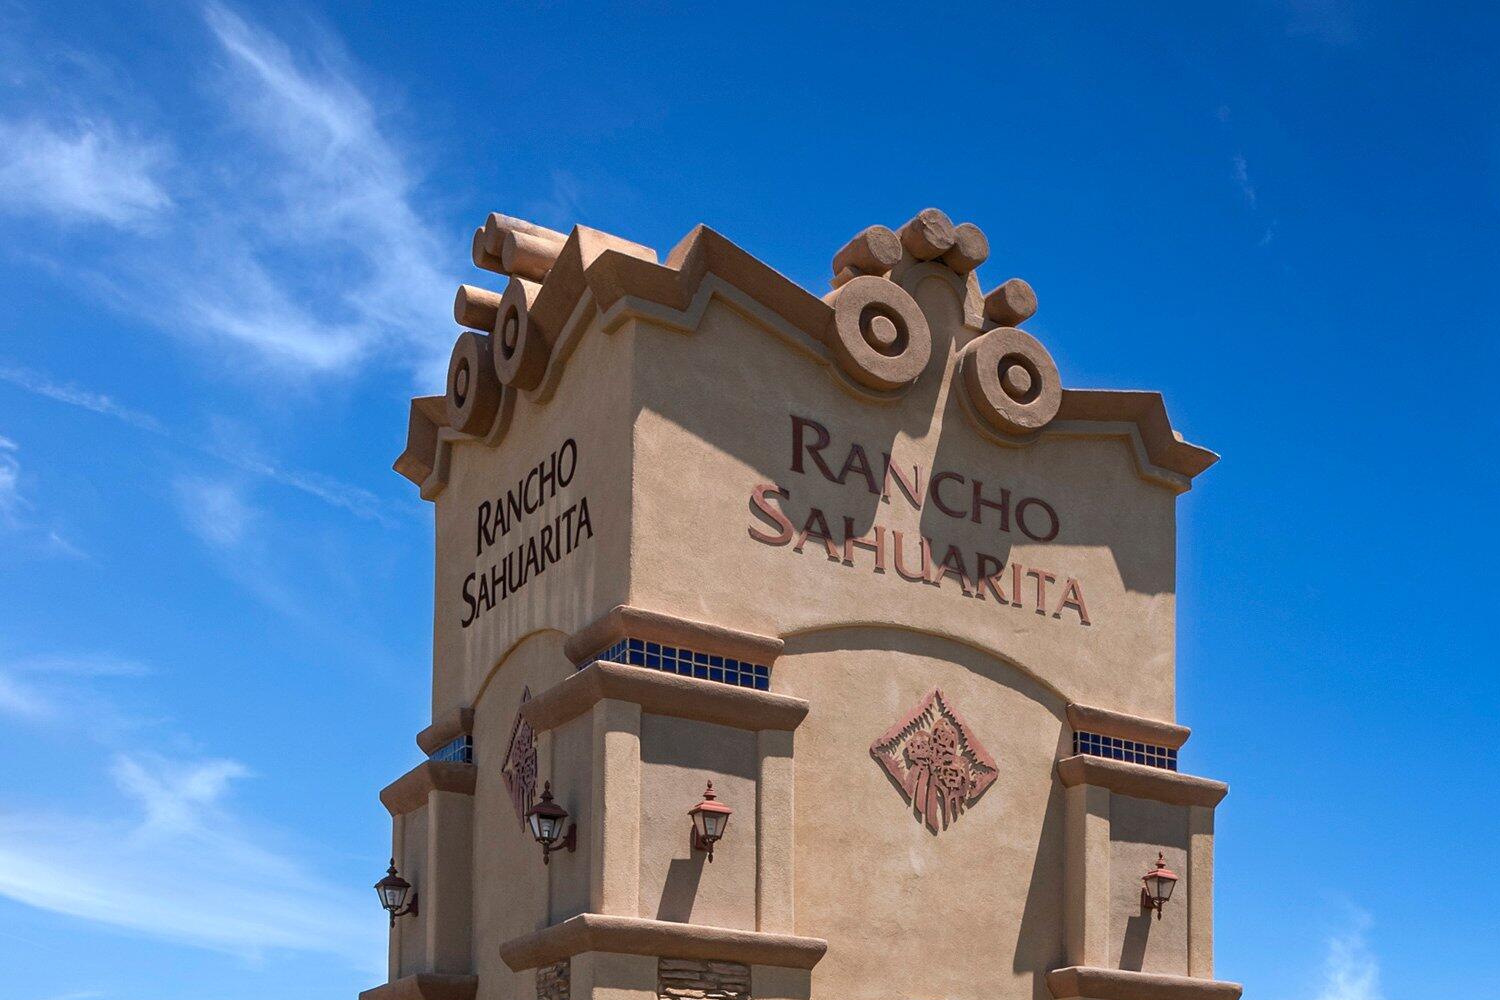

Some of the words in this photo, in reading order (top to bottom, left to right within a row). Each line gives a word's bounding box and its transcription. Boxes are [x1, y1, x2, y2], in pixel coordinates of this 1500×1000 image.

[477, 438, 577, 557] RANCHO
[790, 414, 1060, 543] RANCHO
[461, 496, 593, 628] SAHUARITA
[748, 483, 1092, 626] SAHUARITA
